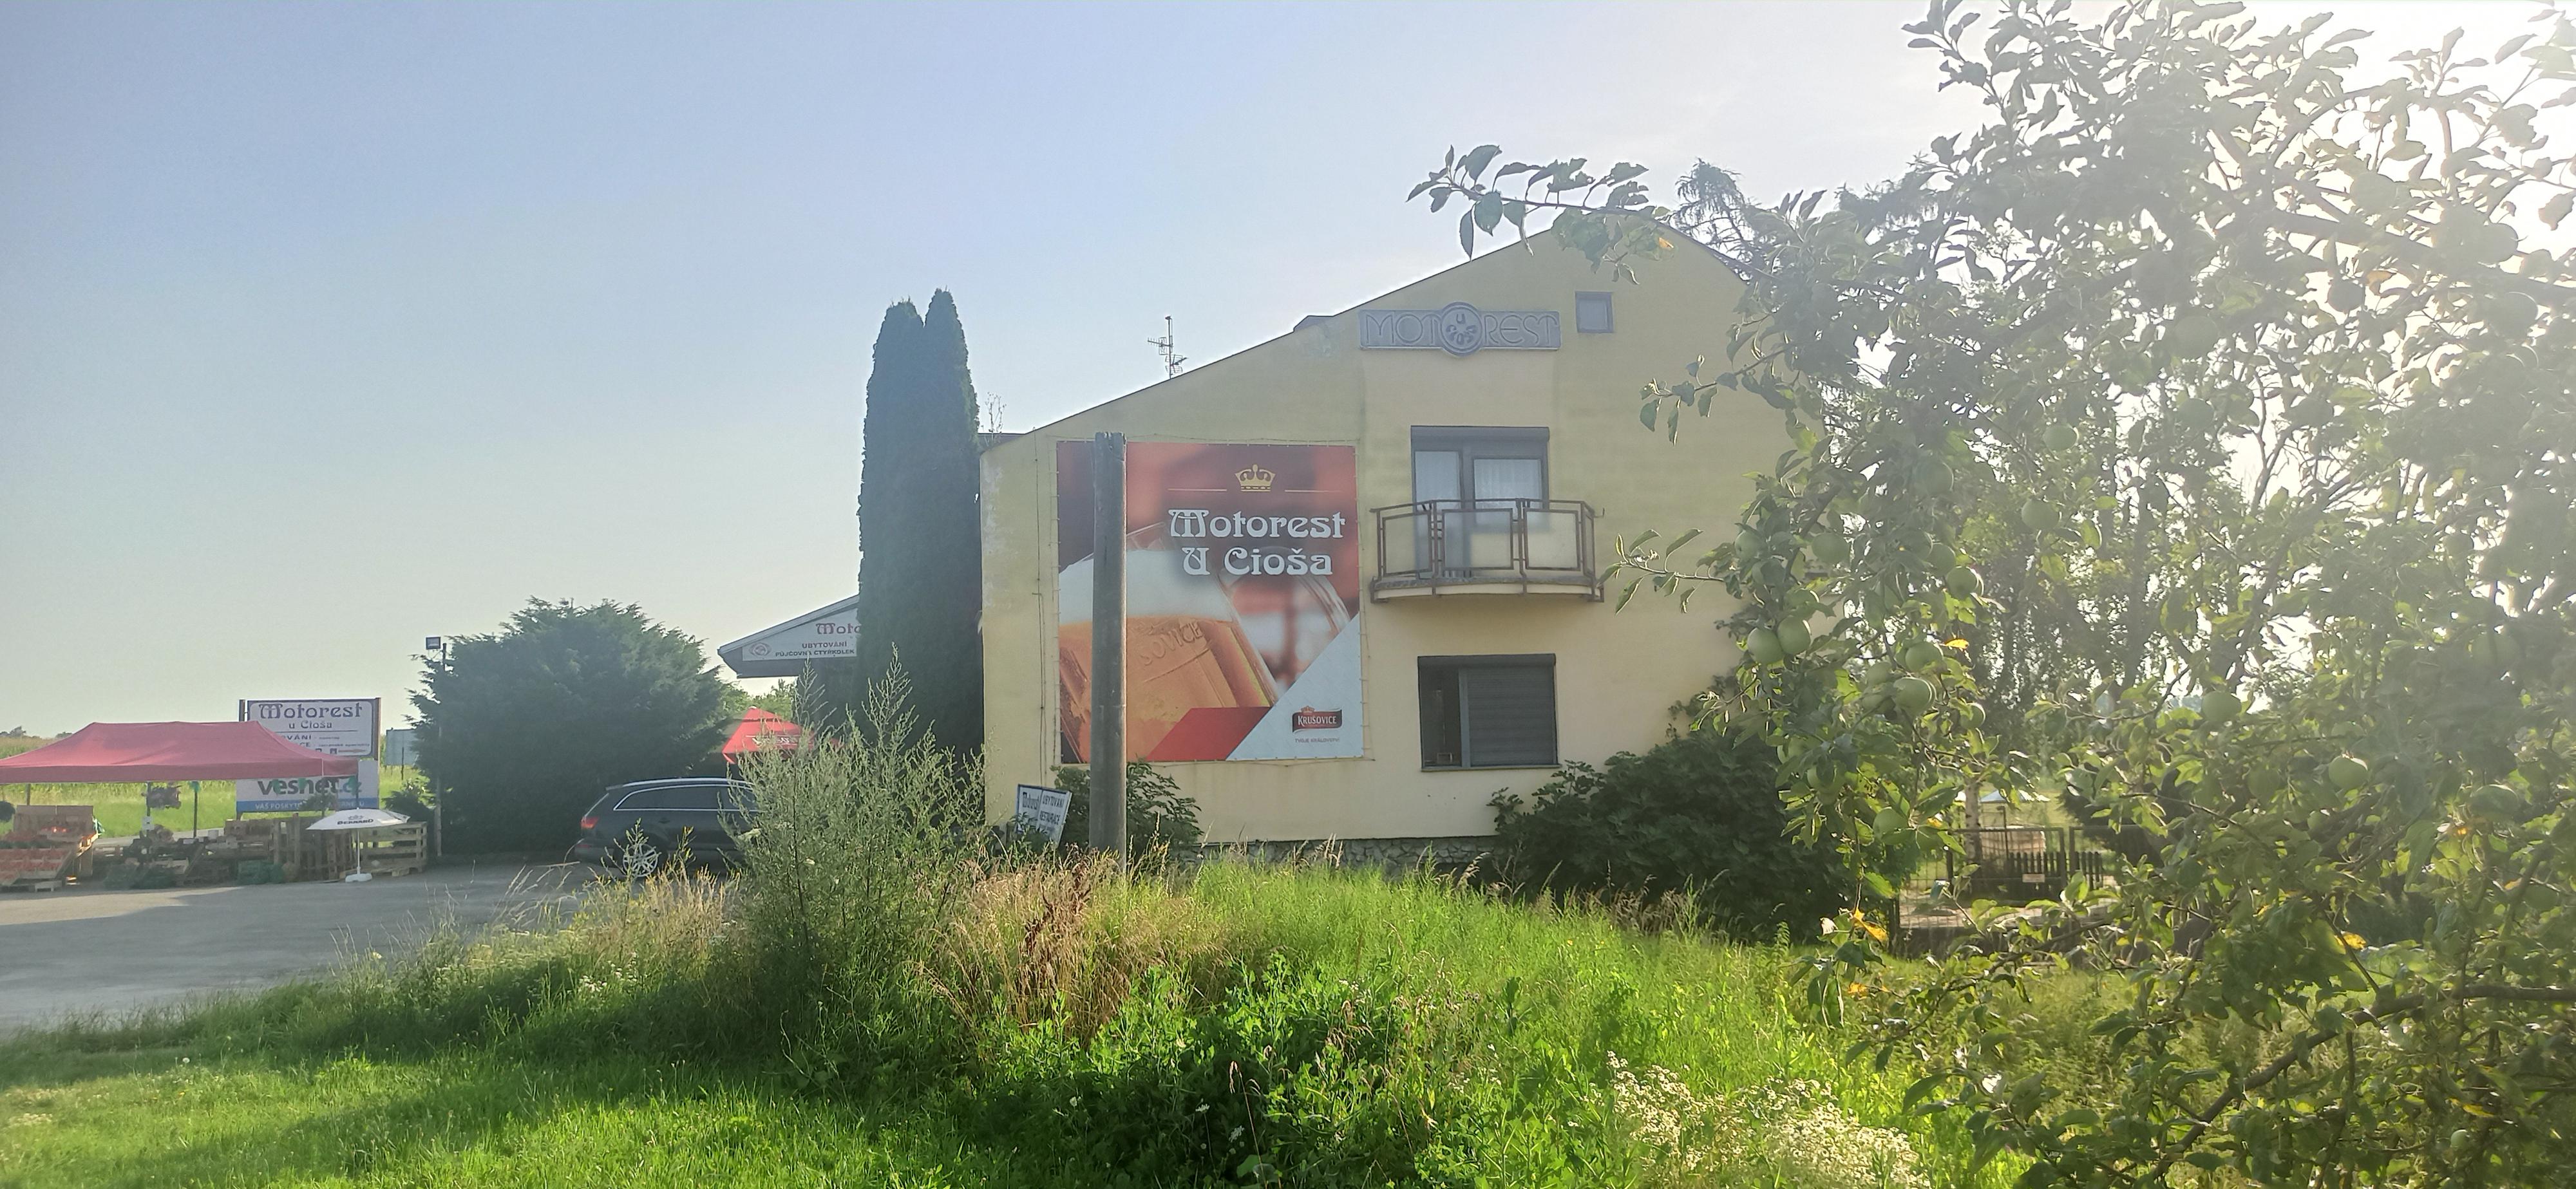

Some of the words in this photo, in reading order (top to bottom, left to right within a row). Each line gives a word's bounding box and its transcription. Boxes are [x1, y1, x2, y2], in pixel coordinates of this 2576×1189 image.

[1168, 509, 1346, 538] Motorest
[1182, 547, 1211, 575] U
[1224, 547, 1333, 576] Cioša
[259, 702, 362, 718] Motorest
